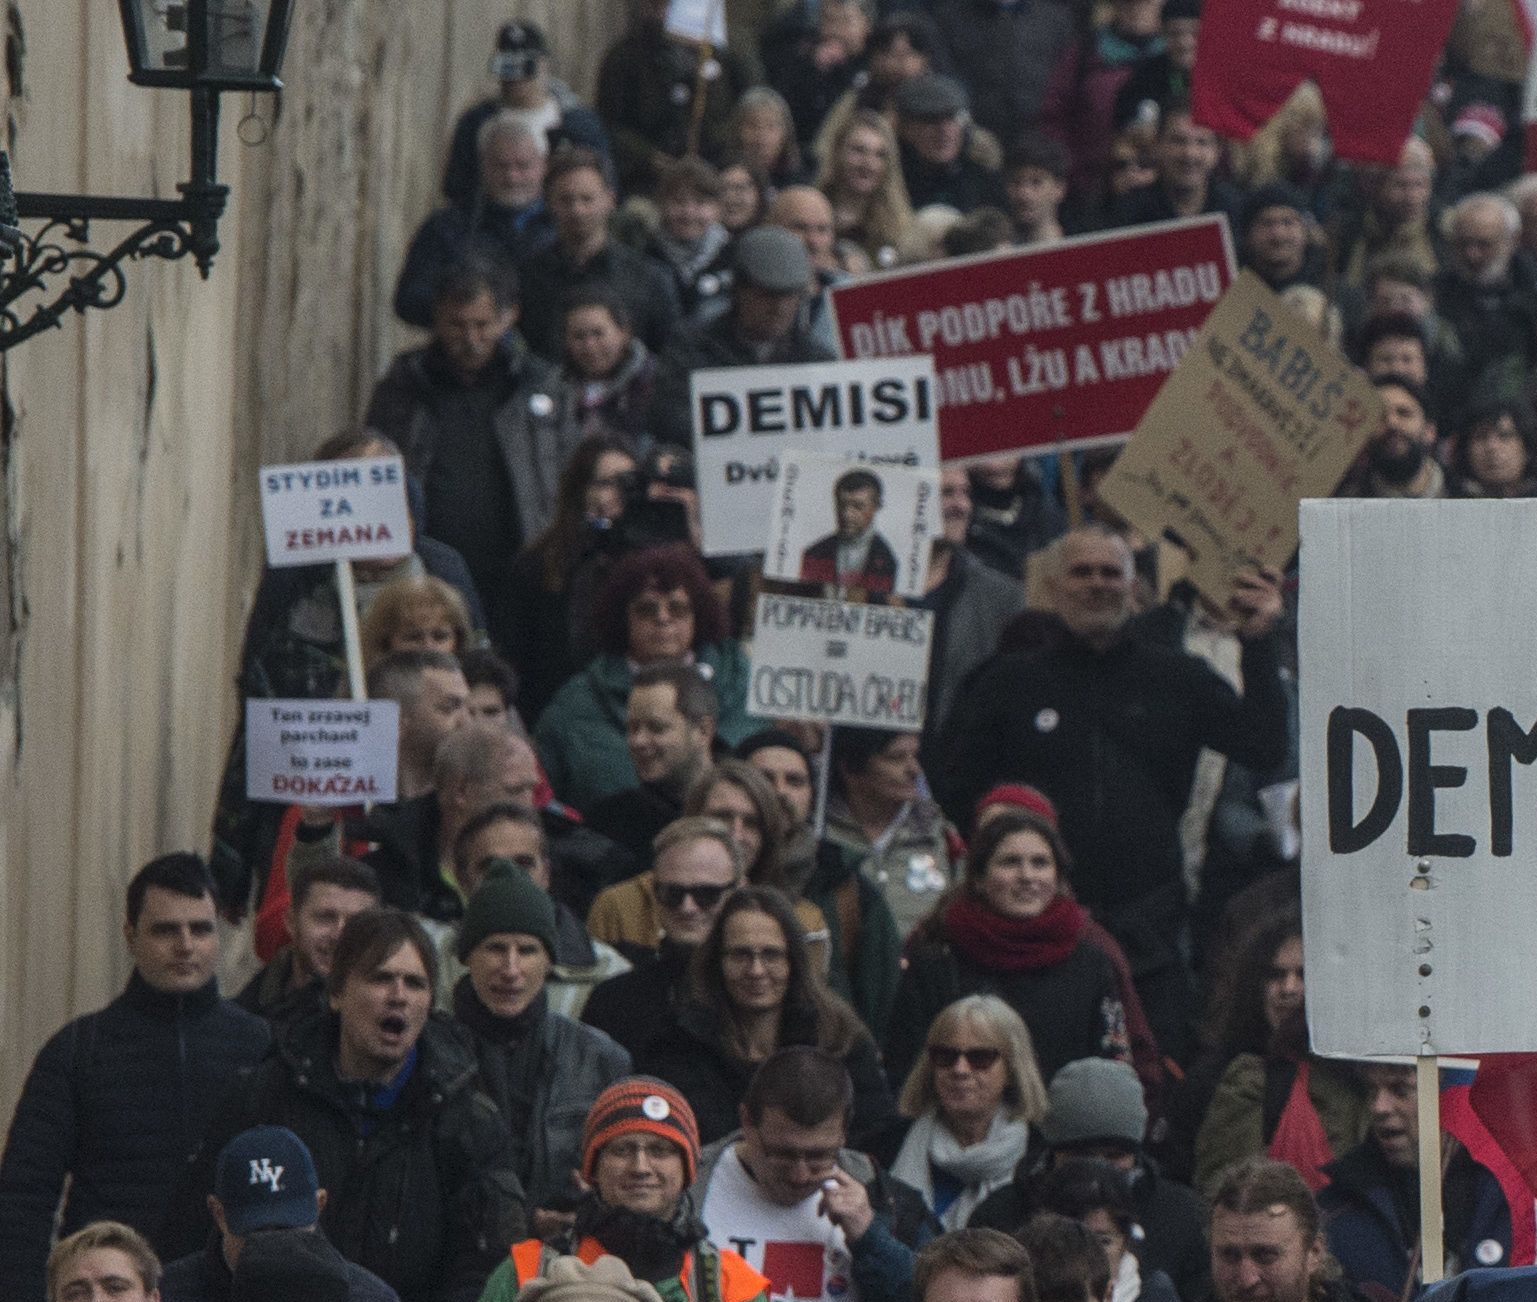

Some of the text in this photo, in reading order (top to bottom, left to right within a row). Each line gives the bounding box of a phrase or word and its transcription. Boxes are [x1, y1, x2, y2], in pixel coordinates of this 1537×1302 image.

[850, 261, 1224, 358] DÍK PODPOŘE Z HRADU
[1008, 344, 1068, 397] LŽU
[1075, 345, 1099, 385] A
[1101, 326, 1198, 381] KRAD
[701, 376, 931, 438] DEMISI
[369, 463, 398, 485] SE
[320, 498, 354, 519] ZA
[286, 523, 393, 550] ZEMANA
[249, 1158, 285, 1192] NY
